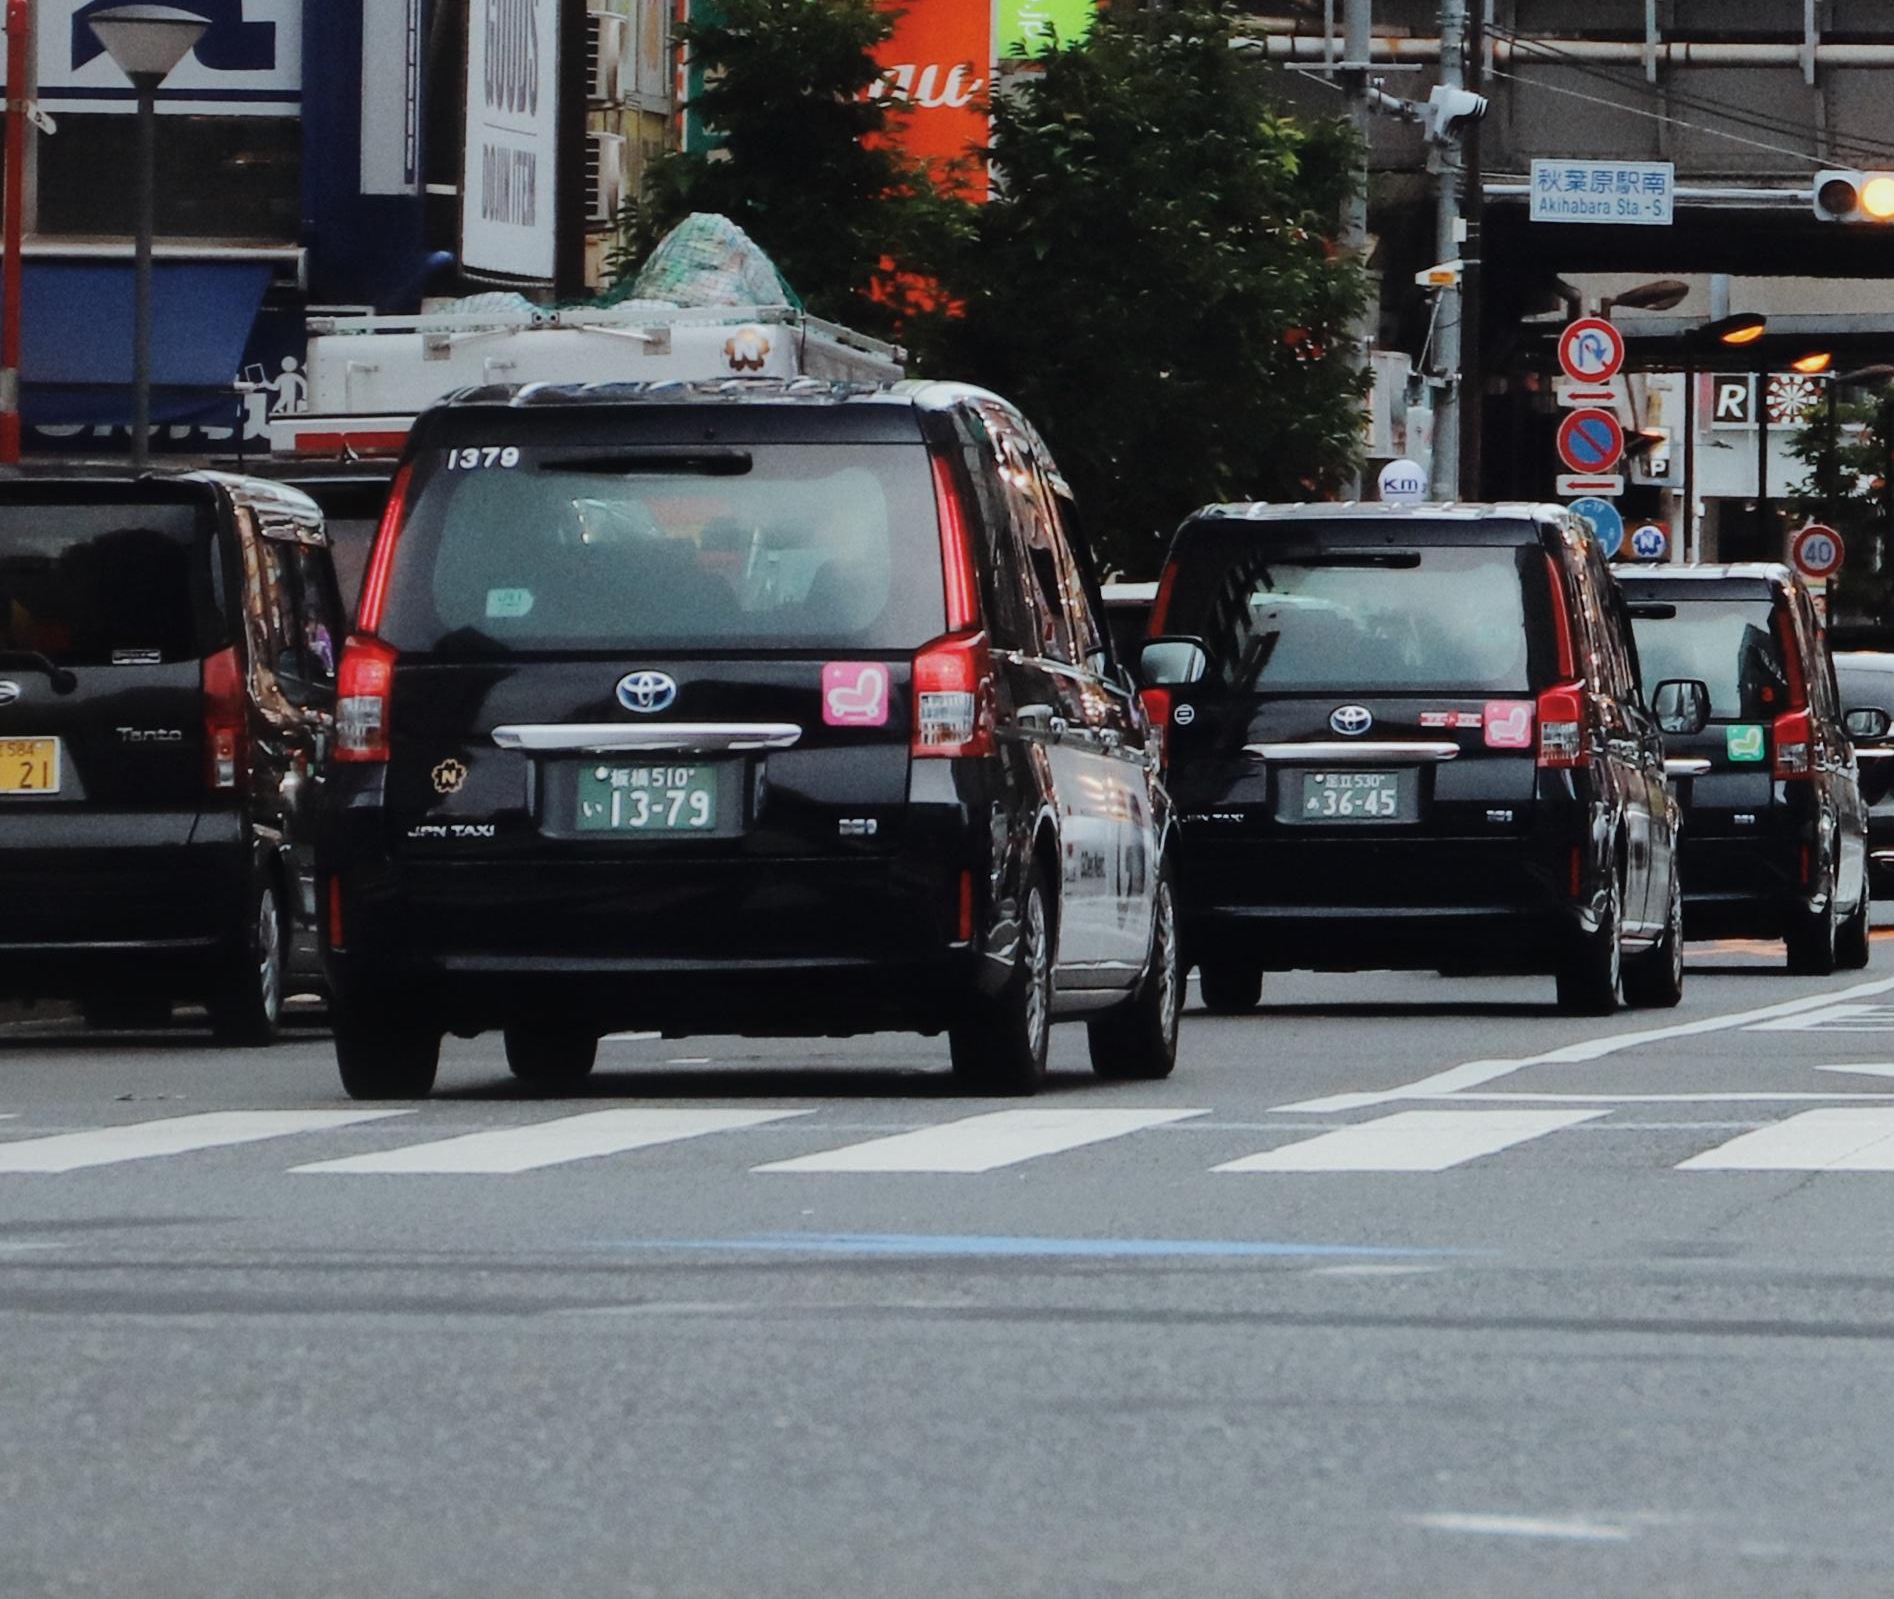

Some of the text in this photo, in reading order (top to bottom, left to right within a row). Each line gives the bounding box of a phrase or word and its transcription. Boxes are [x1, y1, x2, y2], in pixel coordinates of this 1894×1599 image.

[1538, 168, 1667, 196] 秋葉原駅南
[1540, 197, 1611, 215] Akihabara
[445, 445, 520, 470] 1379
[1803, 541, 1833, 564] 40
[115, 726, 183, 742] Tanto
[610, 767, 688, 788] 板橋510
[1325, 773, 1381, 788] 足立530
[609, 789, 711, 827] 13-79
[1322, 788, 1397, 816] 36-45
[407, 825, 496, 838] JPN TAXI
